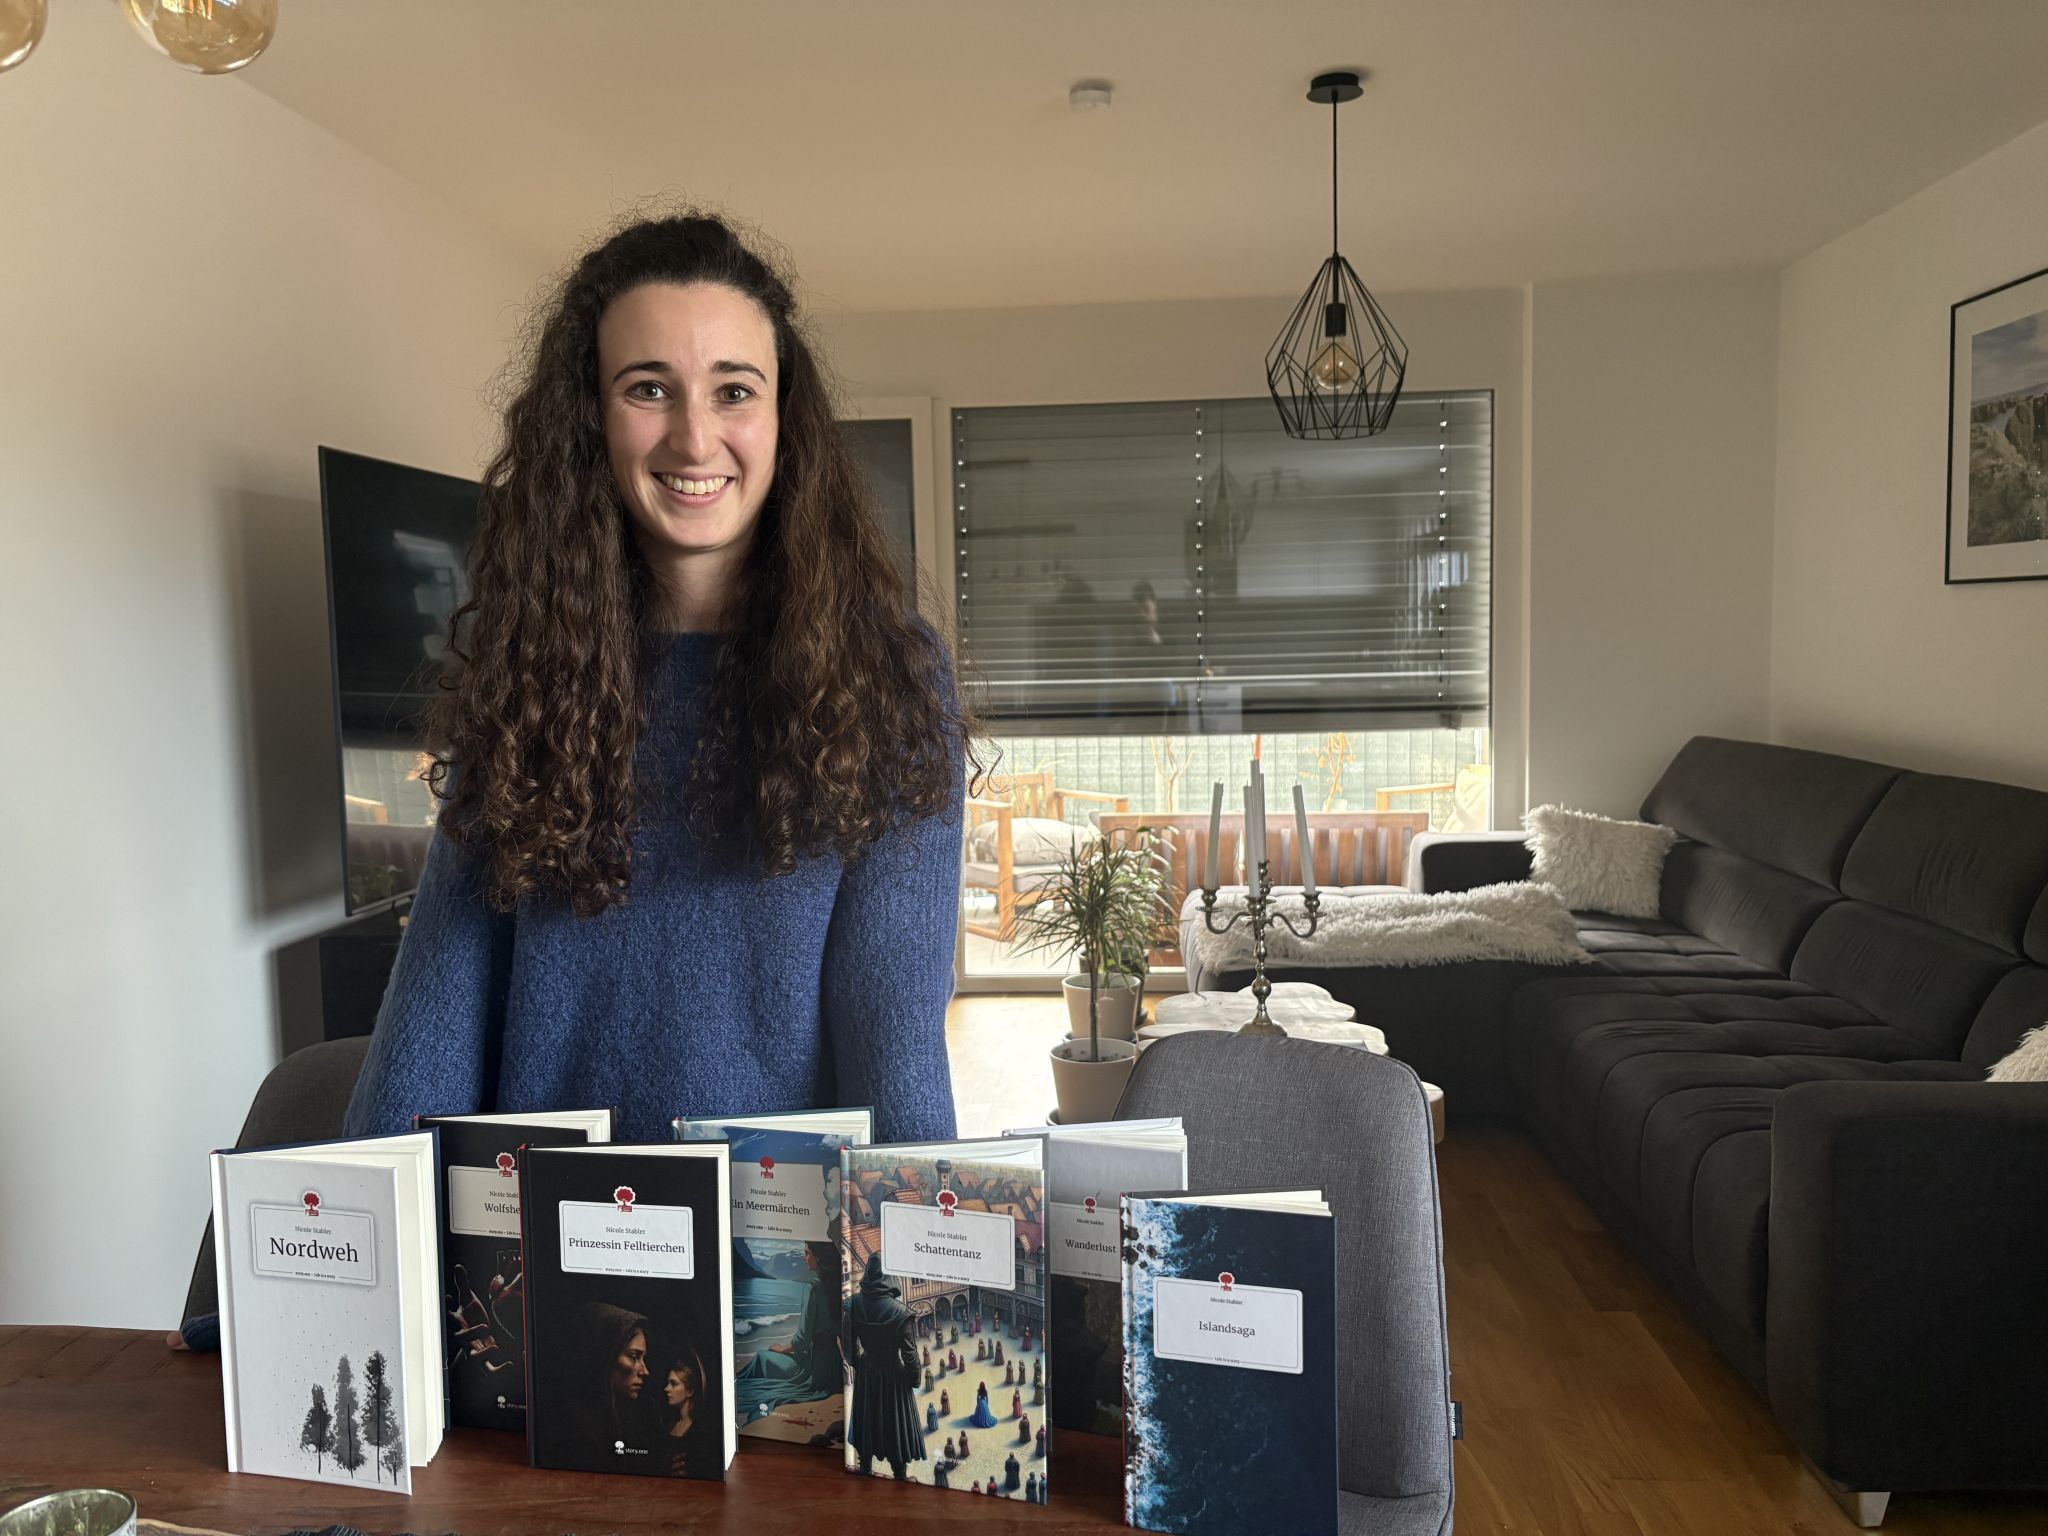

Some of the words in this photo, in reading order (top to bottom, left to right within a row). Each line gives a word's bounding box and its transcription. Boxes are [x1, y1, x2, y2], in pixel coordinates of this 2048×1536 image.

[506, 1191, 519, 1199] Stabl
[484, 1202, 520, 1214] Wolfshe
[745, 1200, 810, 1216] Meermärchen
[294, 1225, 312, 1233] Nicole
[605, 1226, 624, 1234] Nicole
[927, 1230, 946, 1239] Nicole
[269, 1237, 359, 1262] Nordweh
[568, 1237, 621, 1250] Prinzessin
[623, 1240, 685, 1253] Felltierchen
[914, 1242, 982, 1260] Schattentanz
[1065, 1238, 1117, 1253] Wanderlust
[1199, 1320, 1255, 1338] Islandsaga
